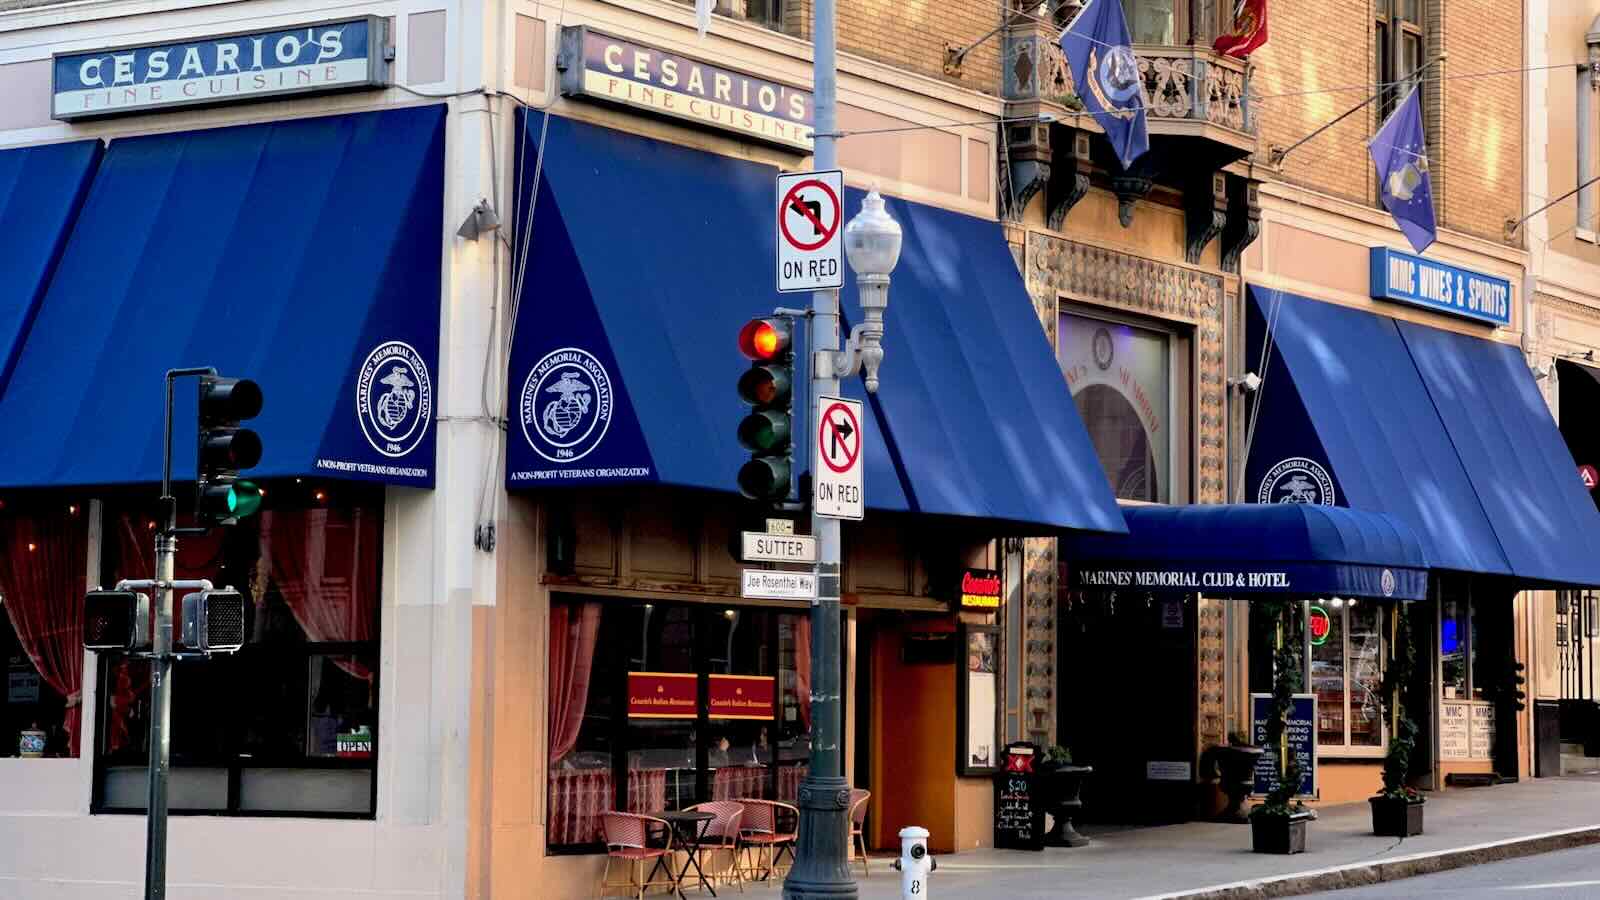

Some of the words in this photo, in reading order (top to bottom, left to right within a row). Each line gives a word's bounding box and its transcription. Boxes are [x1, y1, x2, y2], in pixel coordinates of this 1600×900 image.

[80, 28, 346, 88] CESARIO'S
[83, 86, 163, 109] FINE
[183, 65, 338, 96] CUISINE
[604, 45, 806, 120] CESARIO'S
[608, 79, 675, 109] FINE
[690, 100, 803, 140] CUISINE
[784, 260, 803, 279] ON
[809, 258, 837, 277] RED
[1389, 256, 1416, 295] MMC
[1419, 264, 1453, 304] WINES
[1456, 275, 1465, 307] &
[1468, 278, 1507, 317] SPIRITS
[371, 346, 410, 366] MEMORIAL
[409, 355, 430, 419] ASSOCIATION
[537, 353, 583, 376] MEMORIAL
[583, 358, 609, 420] ASSOCIATION
[386, 443, 401, 453] 1946
[556, 448, 574, 458] 1946
[323, 460, 357, 472] NON-PROFIT
[357, 463, 386, 475] VETERANS
[387, 466, 428, 477] ORGANIZATION
[511, 472, 517, 480] A
[517, 470, 557, 480] NON-PROFIT
[559, 468, 595, 479] VETERANS
[596, 467, 649, 477] ORGANIZATION
[819, 482, 833, 501] ON
[838, 484, 860, 503] RED
[1272, 461, 1309, 477] MEMORIAL
[1309, 464, 1332, 505] ASSOCIATIO
[757, 539, 803, 556] SUTTER
[747, 575, 760, 588] Joe
[762, 575, 797, 589] Rosenthal
[799, 577, 813, 592] Way
[1080, 571, 1132, 585] MARINES'
[1135, 572, 1200, 586] MEMORIAL
[1202, 572, 1234, 587] CLUB
[1235, 573, 1245, 587] &
[1248, 573, 1290, 588] HOTEL
[911, 880, 920, 895] 8
